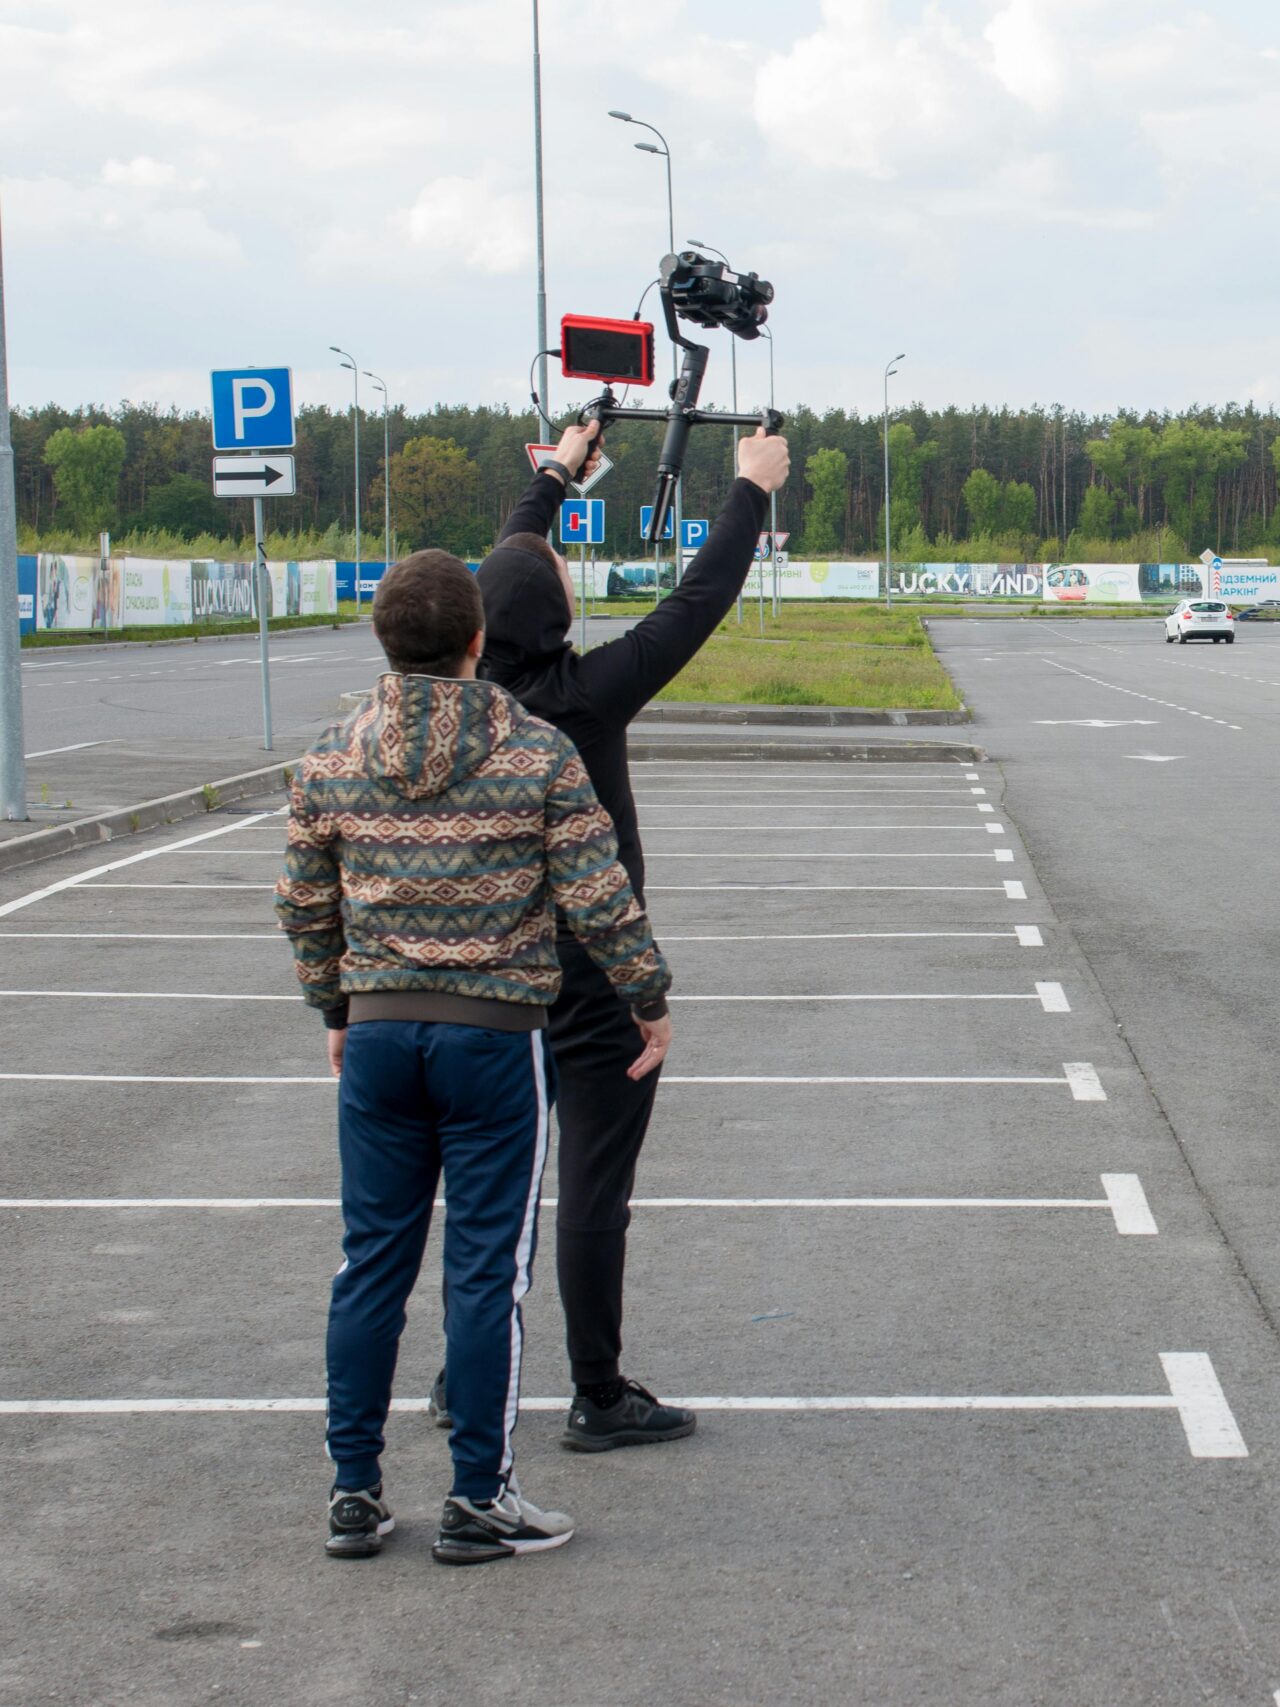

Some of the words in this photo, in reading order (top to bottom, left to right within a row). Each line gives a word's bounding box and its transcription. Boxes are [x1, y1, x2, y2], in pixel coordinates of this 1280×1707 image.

[232, 377, 276, 440] P
[687, 523, 703, 545] P
[342, 1510, 360, 1518] AIR
